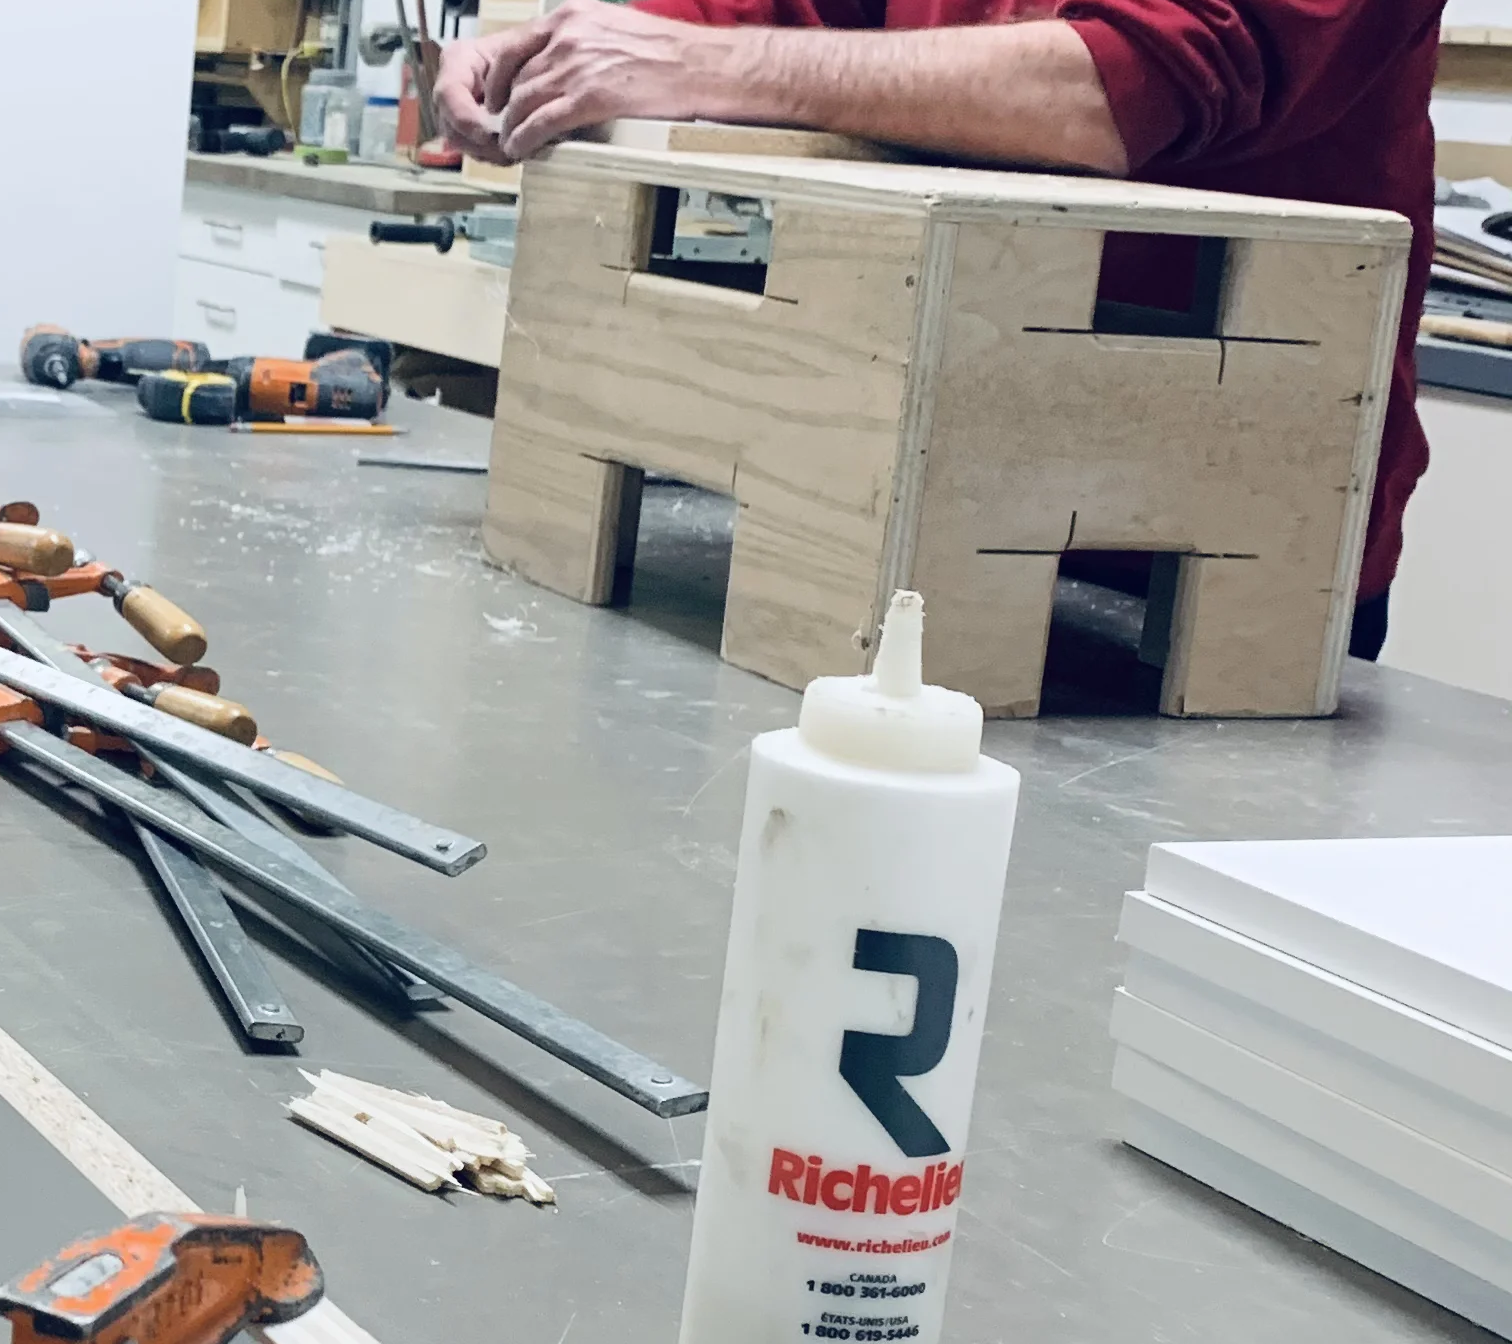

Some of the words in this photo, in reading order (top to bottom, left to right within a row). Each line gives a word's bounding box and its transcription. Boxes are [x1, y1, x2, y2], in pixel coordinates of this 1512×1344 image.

[839, 928, 958, 1158] R
[849, 1273, 897, 1283] CANADA
[806, 1280, 815, 1291] 1
[820, 1282, 855, 1297] 800
[860, 1282, 926, 1299] 361-6000
[801, 1323, 810, 1335] 1
[815, 1325, 850, 1340] 800
